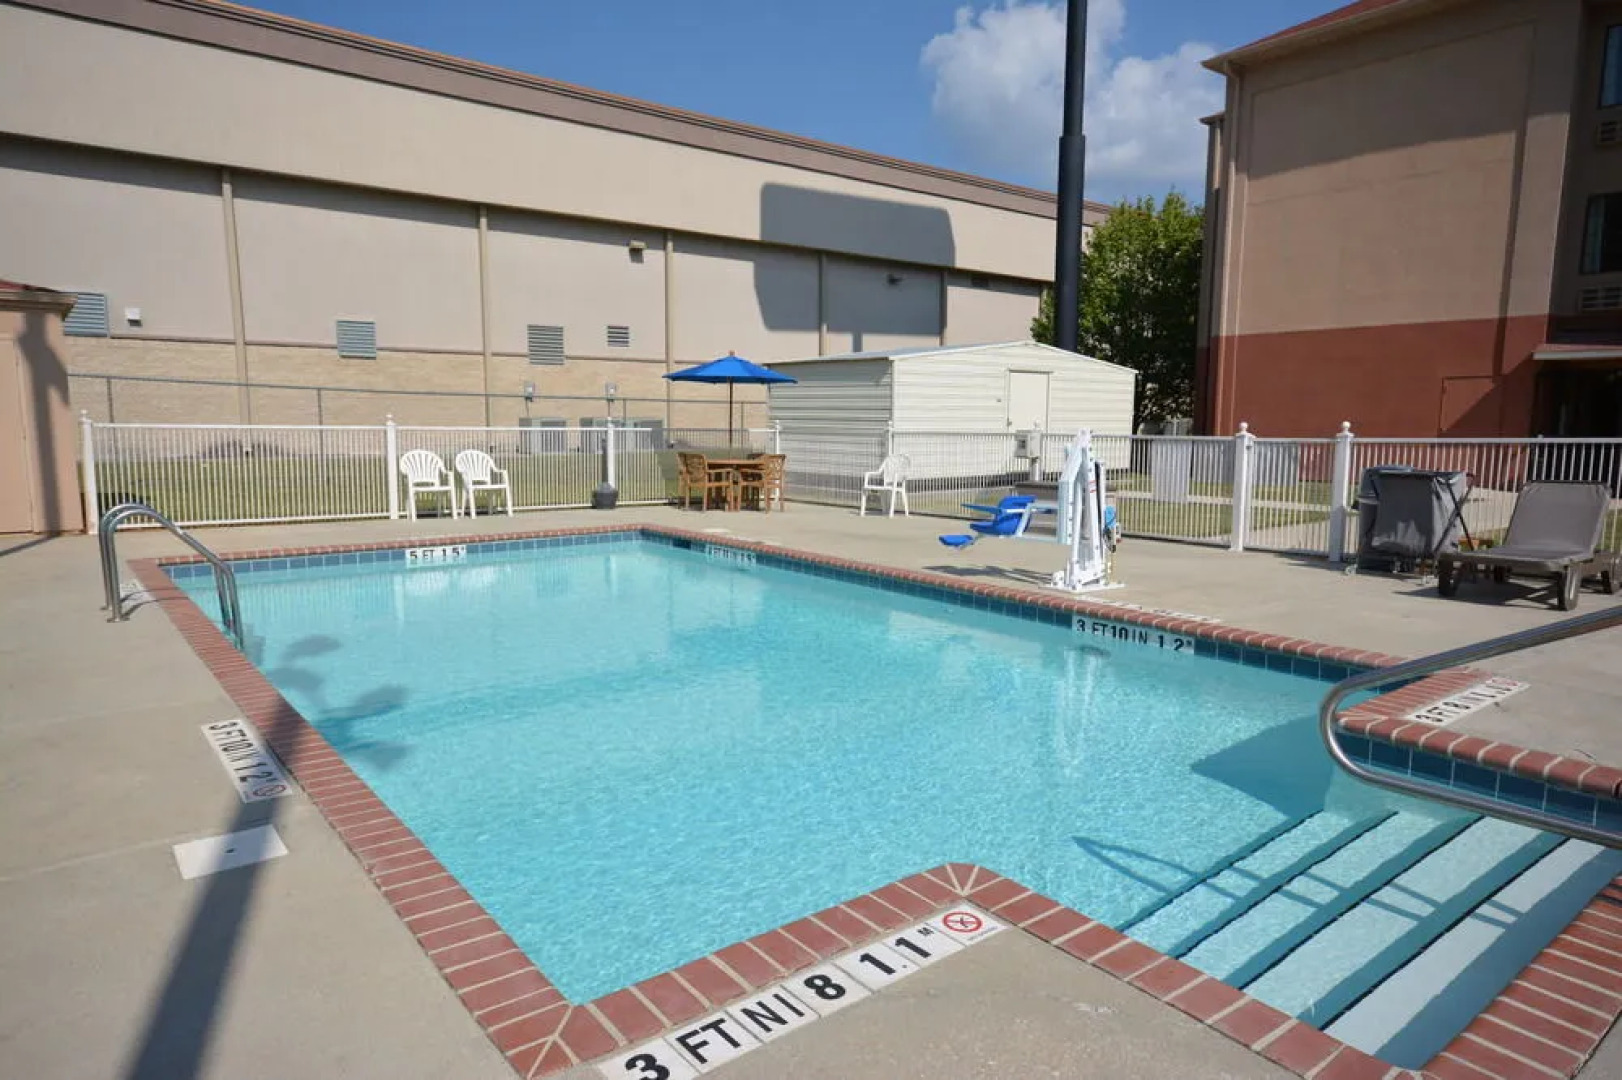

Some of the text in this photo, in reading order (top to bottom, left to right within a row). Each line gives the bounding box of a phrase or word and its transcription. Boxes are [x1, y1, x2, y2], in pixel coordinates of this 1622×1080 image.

[1076, 618, 1086, 632] 3
[1092, 622, 1109, 636] FT
[1132, 628, 1148, 645] IN
[208, 722, 238, 730] 3
[625, 1053, 670, 1080] 3
[675, 1017, 742, 1065] FT
[803, 973, 846, 1000] 8
